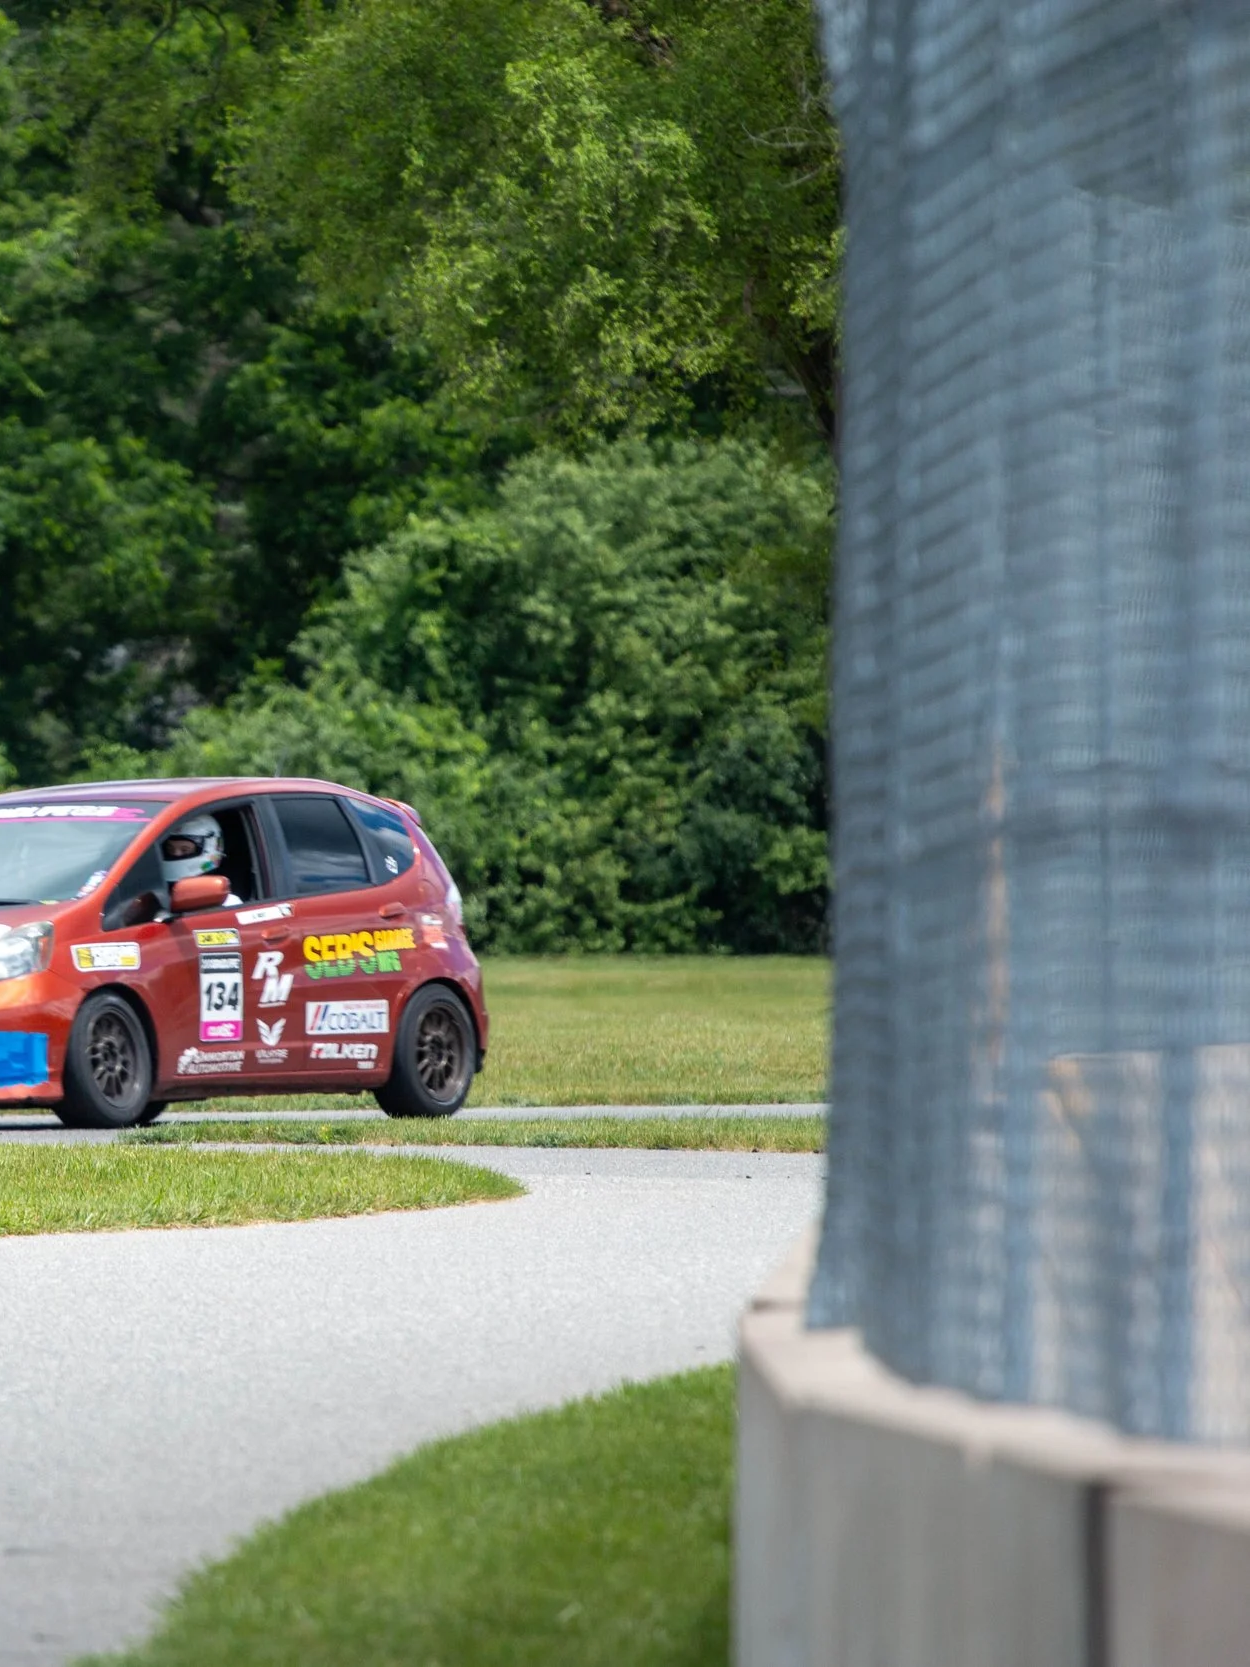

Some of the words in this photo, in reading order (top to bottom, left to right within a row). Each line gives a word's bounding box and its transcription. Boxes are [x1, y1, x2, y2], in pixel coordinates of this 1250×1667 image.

[205, 981, 239, 1011] 134
[328, 1011, 386, 1030] COBALT
[310, 1043, 378, 1060] FALKEN
